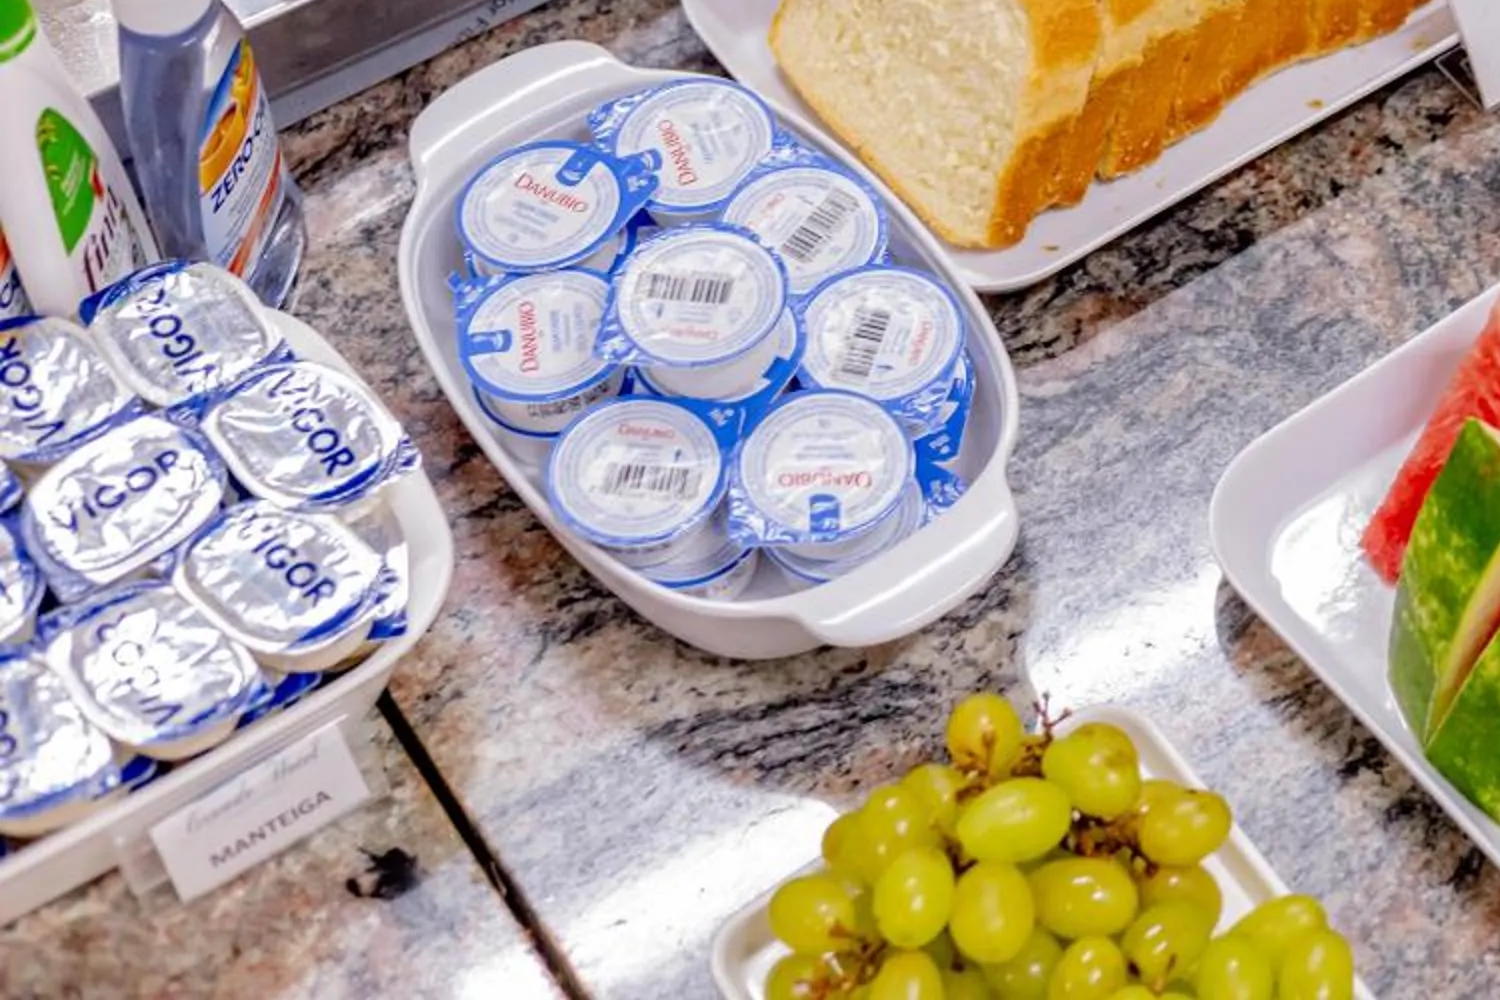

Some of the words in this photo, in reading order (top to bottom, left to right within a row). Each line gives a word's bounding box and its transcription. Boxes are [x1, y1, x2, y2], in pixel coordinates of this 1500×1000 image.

[658, 119, 698, 187] DANUBIO
[514, 171, 589, 213] DANUBIO
[519, 300, 539, 373] DANUBIO
[209, 790, 332, 869] MANTEIGA
